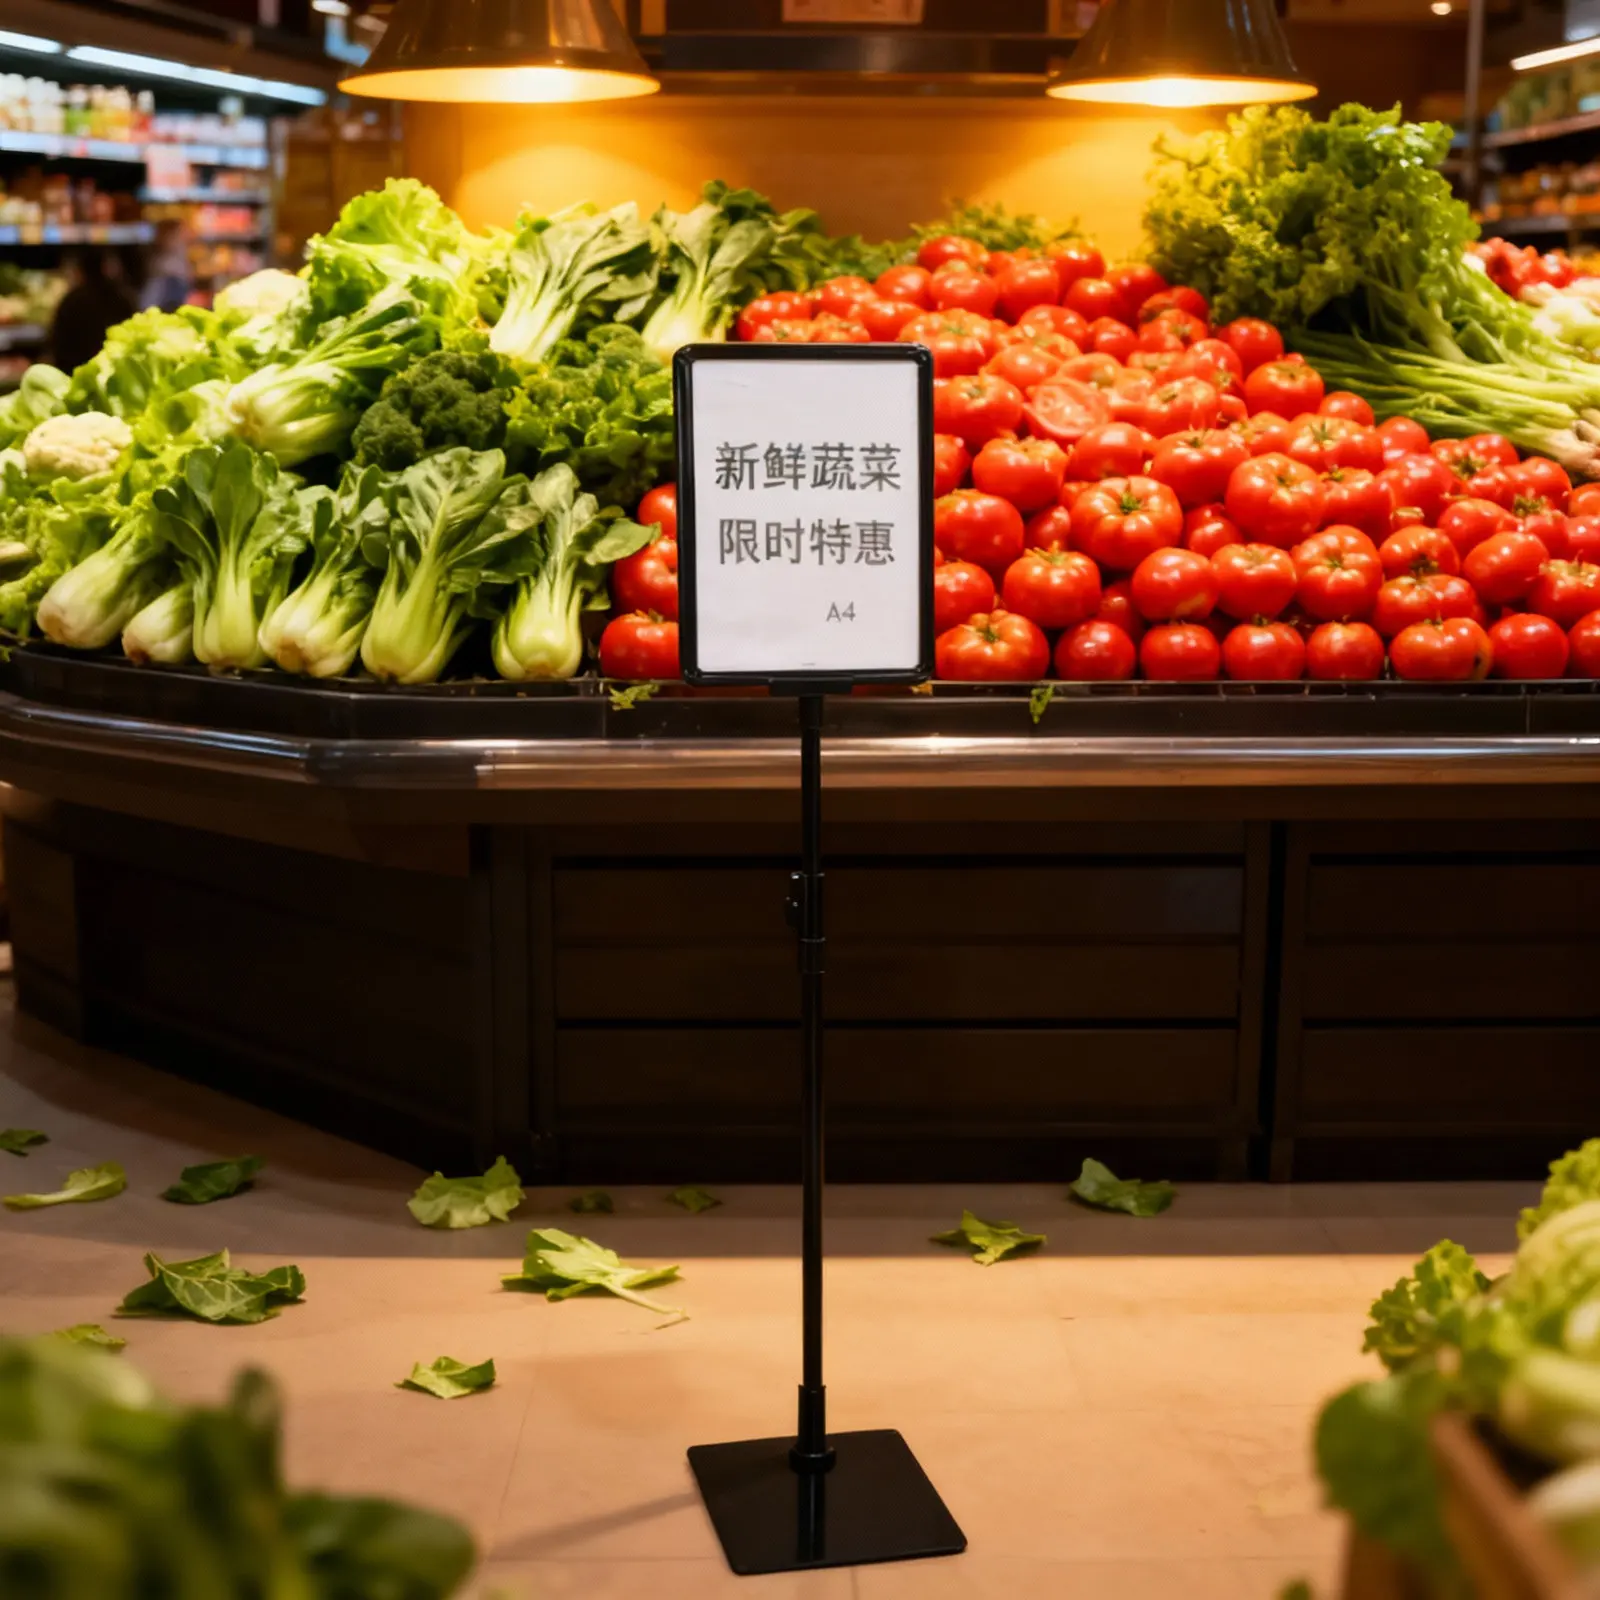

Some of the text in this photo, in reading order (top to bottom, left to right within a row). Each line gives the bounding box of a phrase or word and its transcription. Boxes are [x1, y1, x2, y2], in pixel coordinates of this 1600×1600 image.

[714, 441, 902, 492] 新鲜蔬菜
[719, 517, 895, 566] 限时特惠
[826, 601, 856, 622] A4
